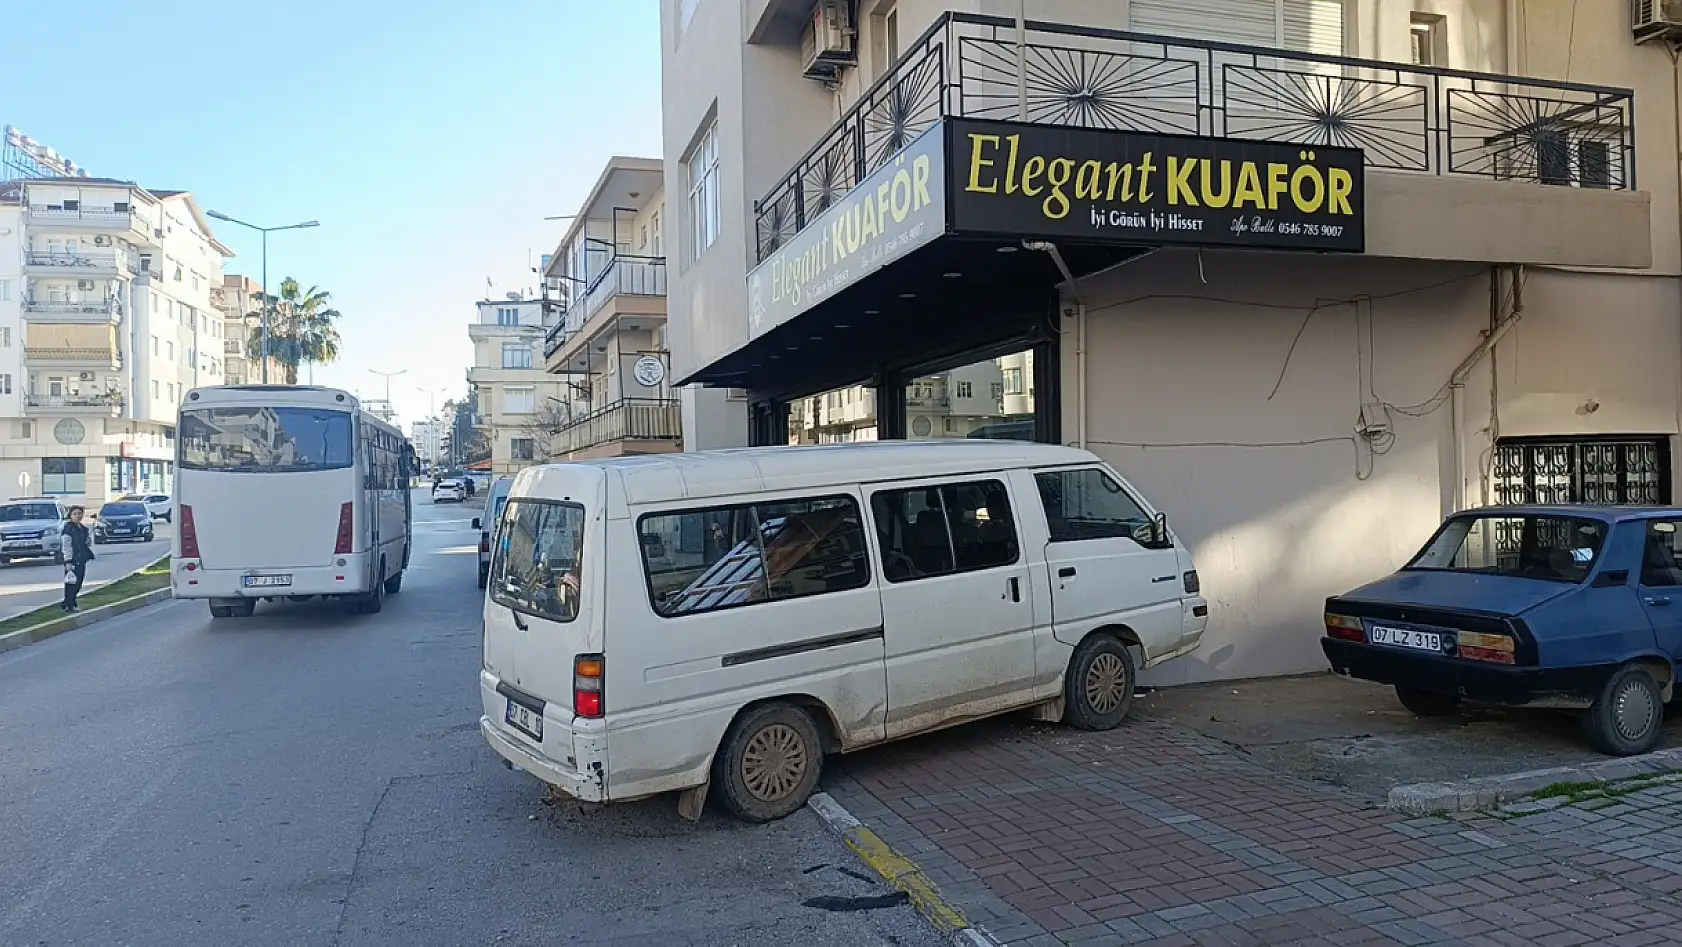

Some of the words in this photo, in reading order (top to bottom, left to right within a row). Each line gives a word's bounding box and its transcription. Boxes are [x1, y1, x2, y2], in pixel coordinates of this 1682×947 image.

[964, 133, 1157, 219] Elegant
[1166, 149, 1354, 215] KUAFÖR
[771, 225, 829, 306] Elegant
[832, 152, 931, 265] KUAFÖR
[1278, 222, 1301, 235] 0546
[1303, 224, 1320, 236] 785
[1321, 225, 1344, 237] 9007
[1374, 627, 1388, 642] 07
[1393, 630, 1409, 645] LZ
[1415, 633, 1439, 649] 319
